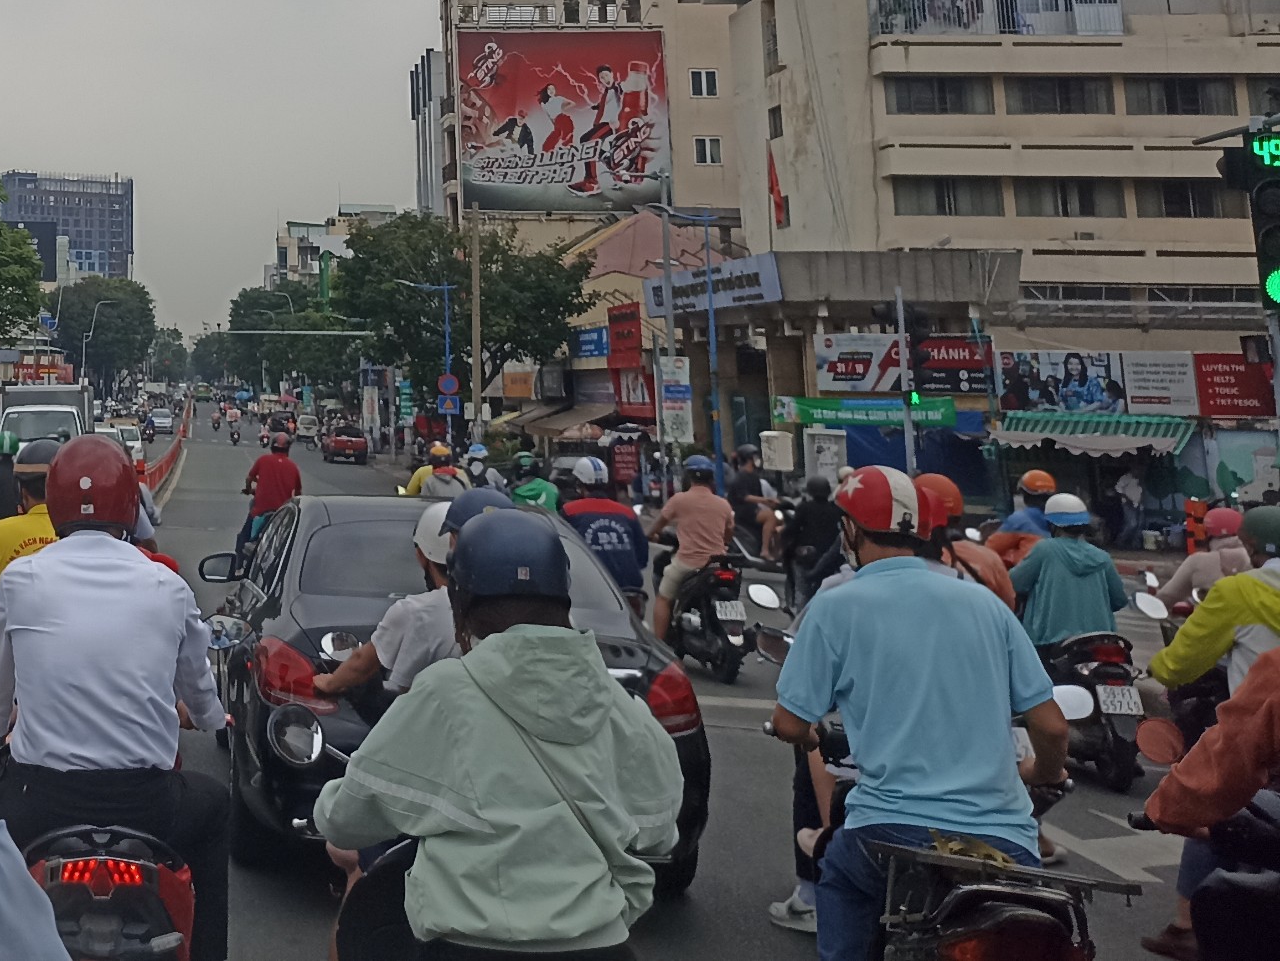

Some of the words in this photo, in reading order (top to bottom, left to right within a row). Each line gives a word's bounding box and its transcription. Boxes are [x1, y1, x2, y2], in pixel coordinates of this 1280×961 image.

[476, 48, 504, 81] STING
[613, 127, 651, 163] STING
[926, 346, 970, 360] HÁNH
[1230, 364, 1246, 372] THI
[1213, 376, 1236, 384] IELTS
[1214, 387, 1240, 395] TOEIC
